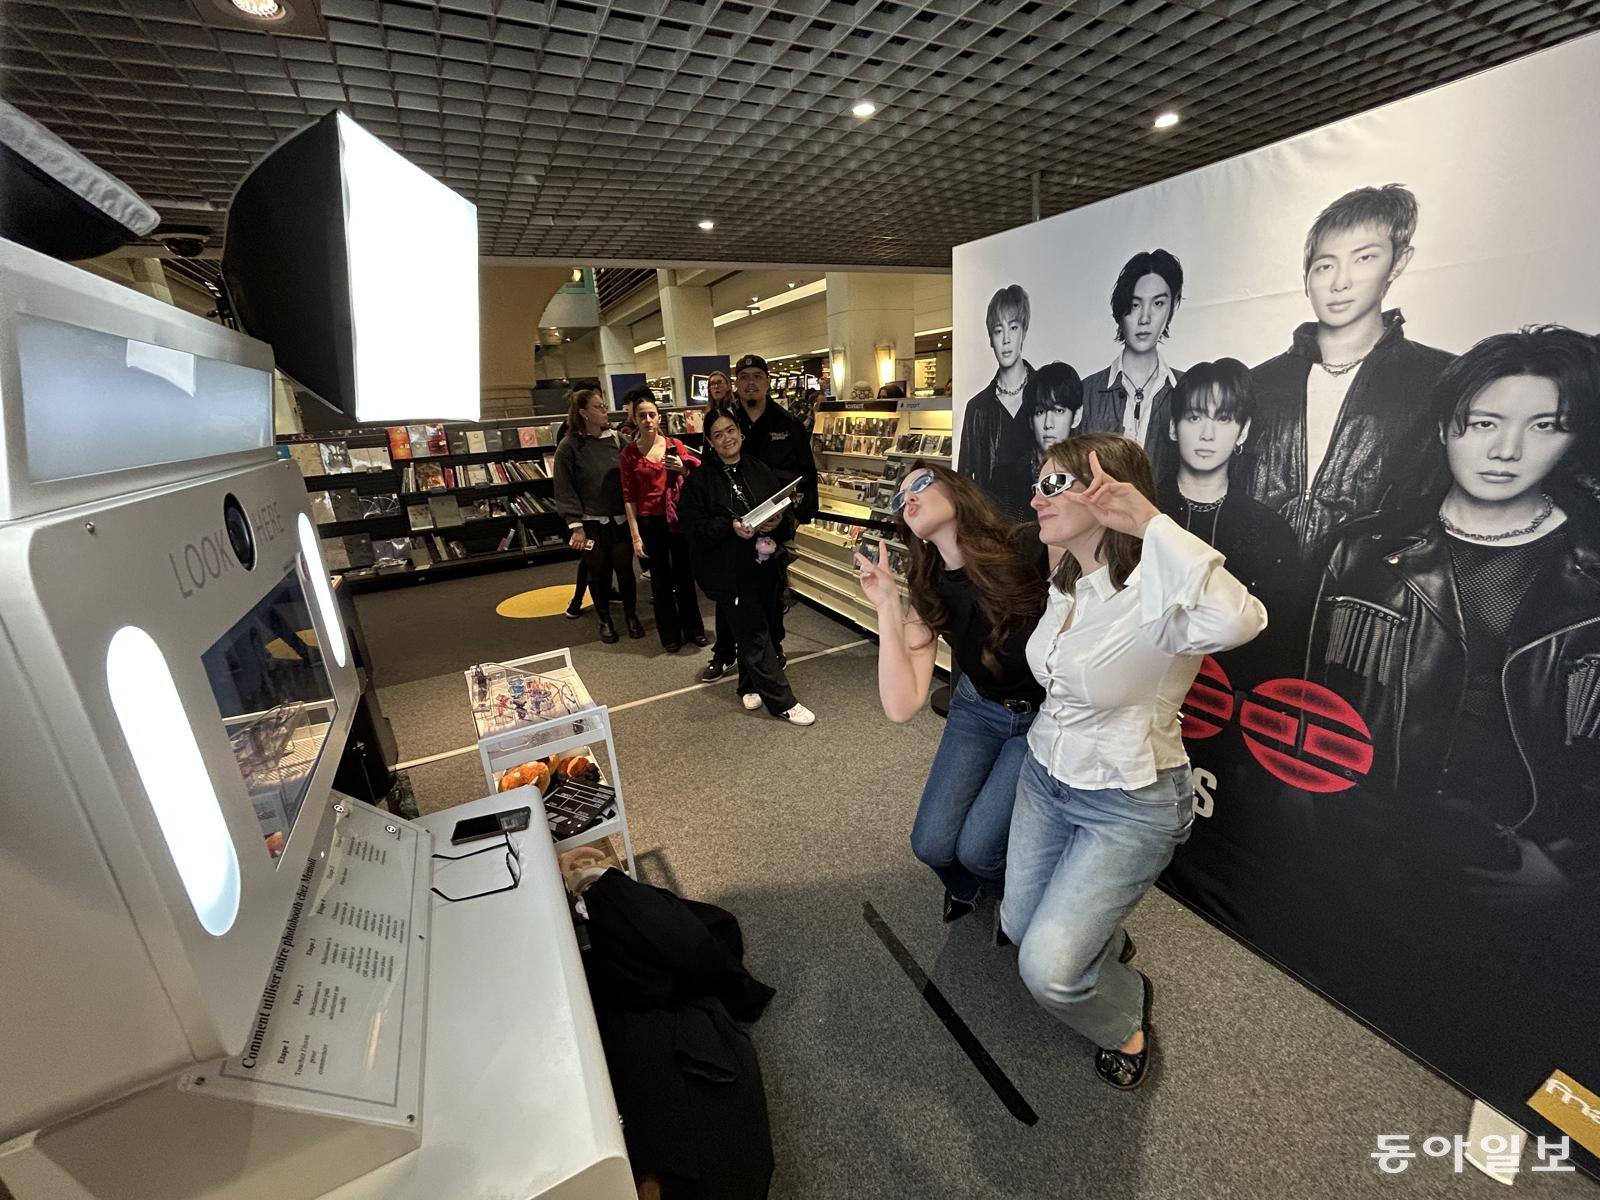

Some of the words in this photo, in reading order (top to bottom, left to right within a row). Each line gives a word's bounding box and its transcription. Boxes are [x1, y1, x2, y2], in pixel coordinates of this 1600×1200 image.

[169, 530, 235, 599] LOOK
[251, 501, 285, 547] HERE
[242, 1012, 270, 1069] Comment
[263, 974, 282, 1010] utiliser
[275, 948, 290, 973] notre
[284, 898, 304, 948] photobooth
[296, 884, 309, 904] chez
